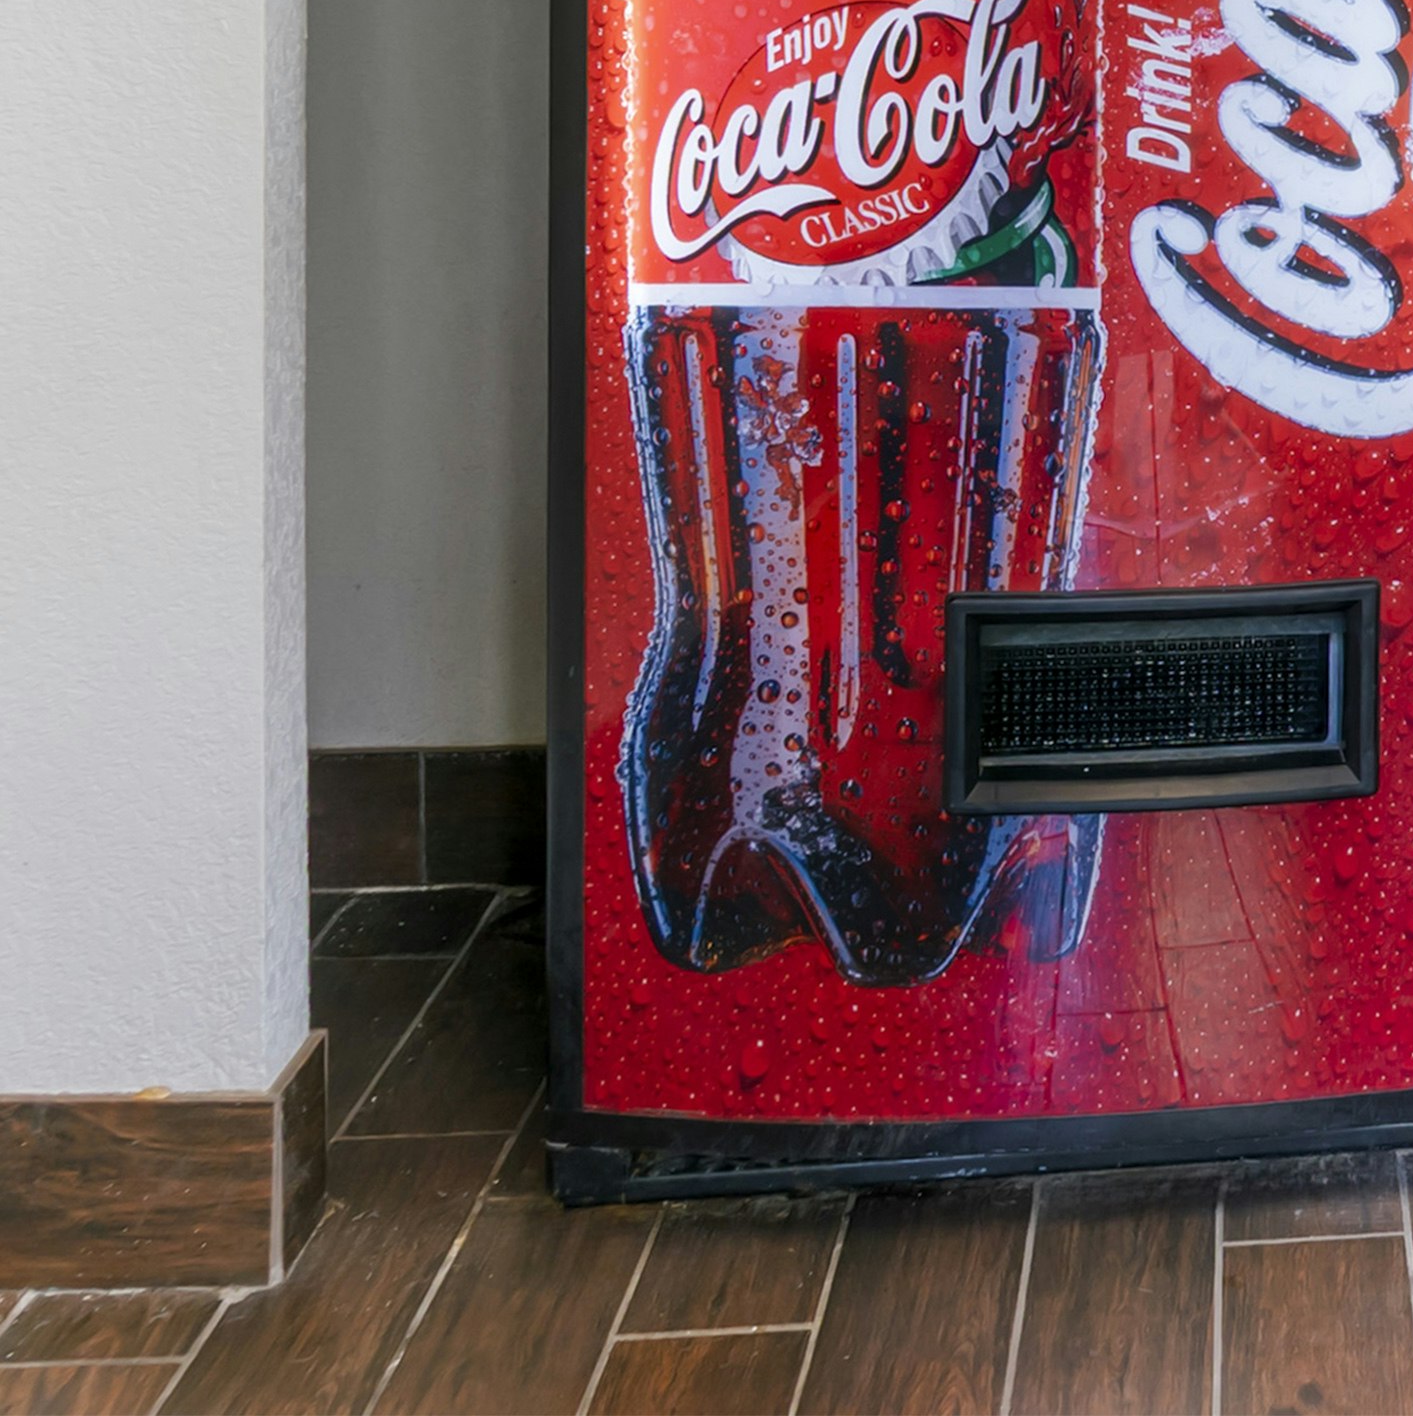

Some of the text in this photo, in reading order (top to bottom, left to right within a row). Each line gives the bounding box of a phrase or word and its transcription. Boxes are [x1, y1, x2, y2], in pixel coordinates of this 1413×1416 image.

[766, 5, 849, 72] Enjoy
[1127, 4, 1193, 173] Drink!
[800, 182, 930, 248] CLASSIC
